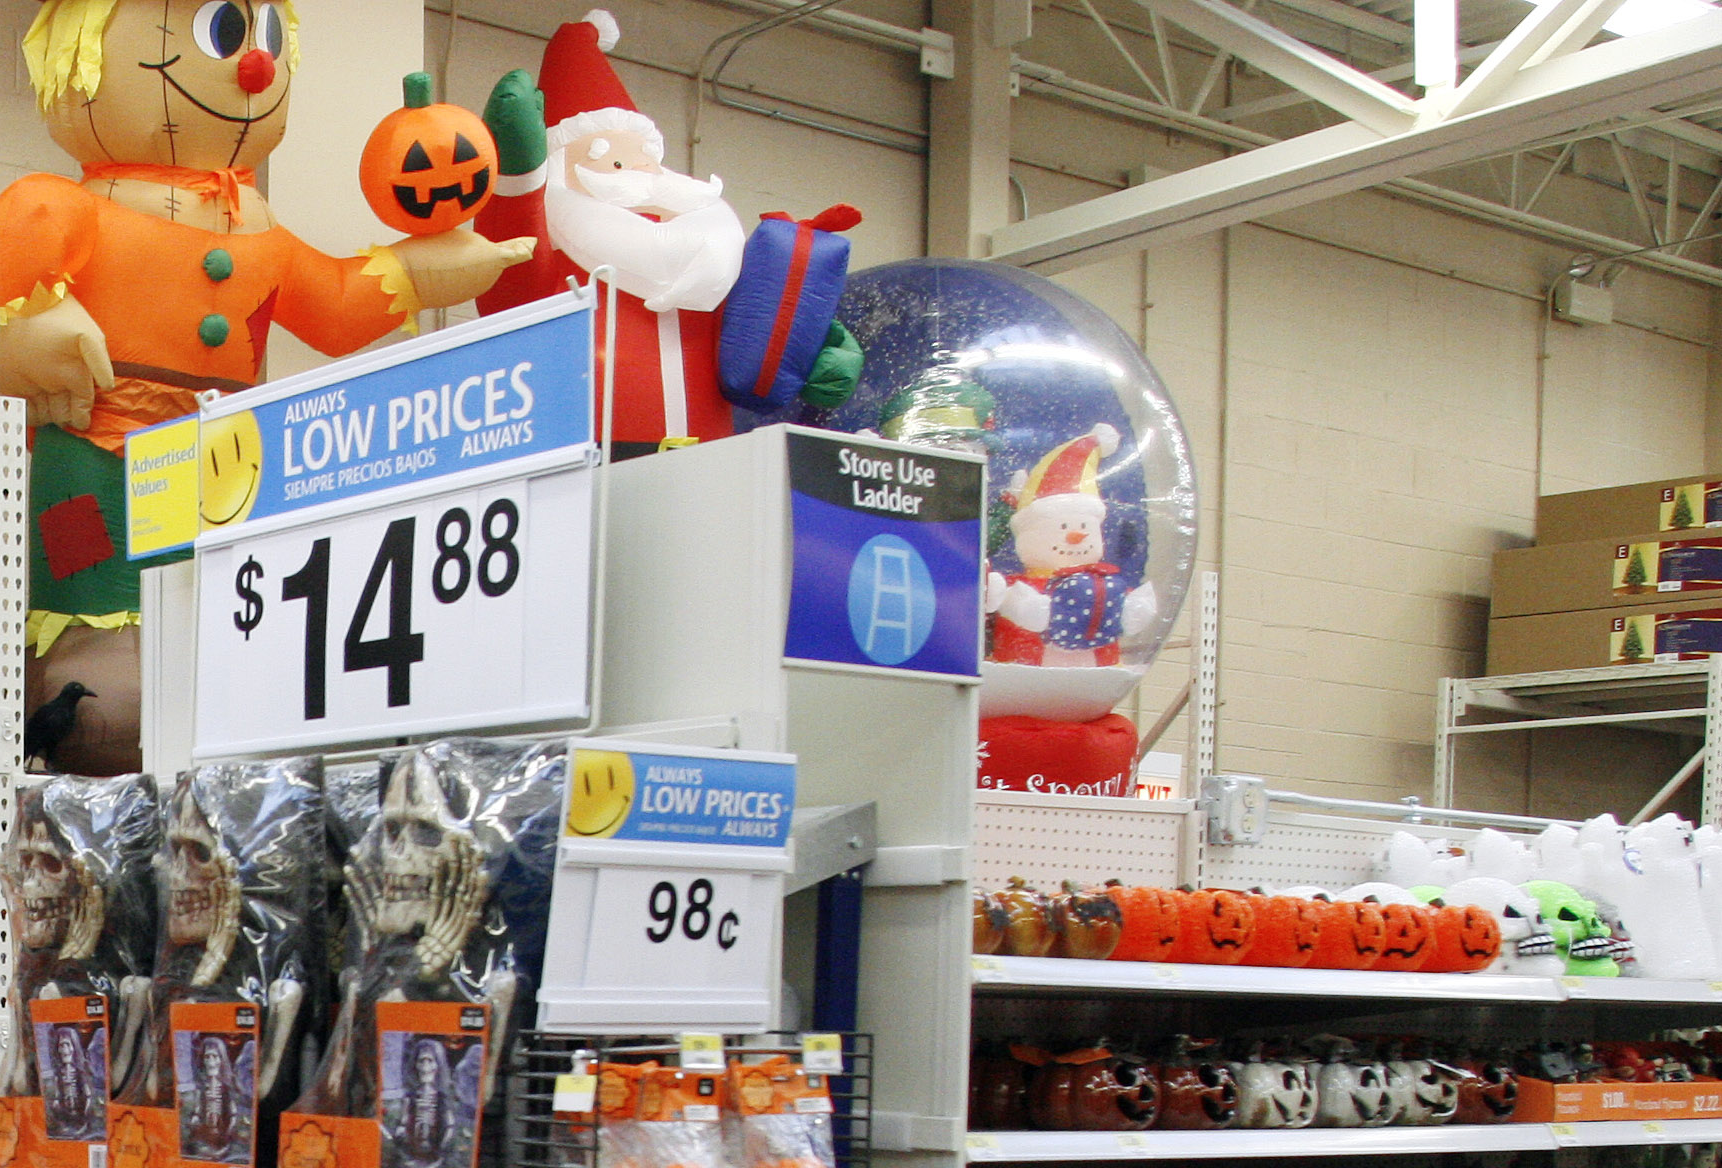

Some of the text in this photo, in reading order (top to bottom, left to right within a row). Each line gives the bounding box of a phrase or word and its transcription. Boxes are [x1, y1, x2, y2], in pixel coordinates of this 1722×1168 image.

[283, 361, 534, 478] LOW PRICES
[284, 389, 347, 425] ALWAYS
[460, 420, 534, 459] ALWAYS
[131, 443, 196, 475] Advertised
[284, 447, 437, 500] SIEMPRE PRECIOS BAJOS
[838, 447, 936, 488] Store Use
[131, 478, 169, 498] Values
[852, 479, 924, 515] Ladder
[645, 766, 703, 786] ALWAYS
[640, 786, 784, 820] LOW PRICES
[720, 820, 779, 838] ALWAYS
